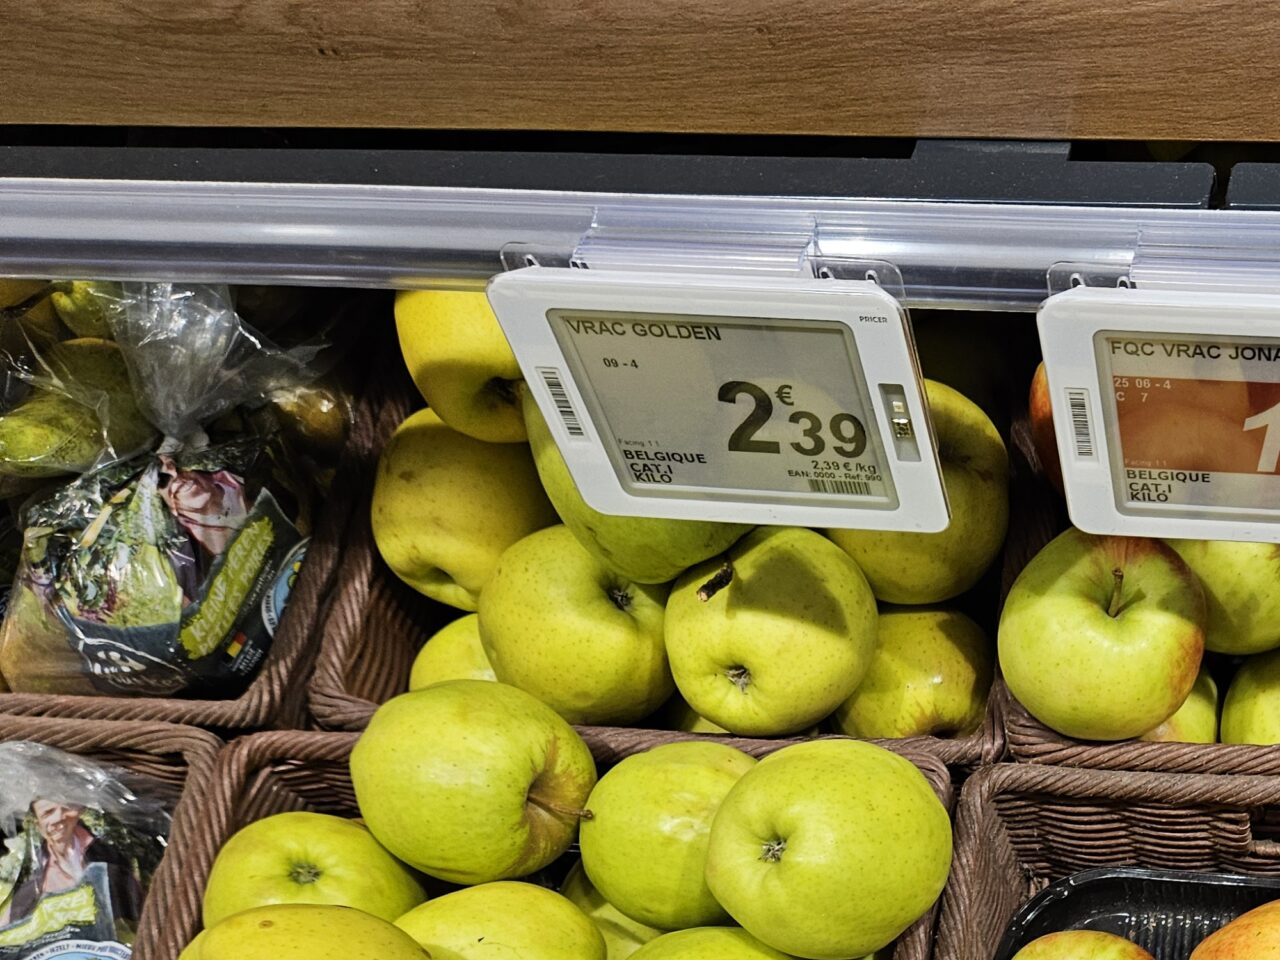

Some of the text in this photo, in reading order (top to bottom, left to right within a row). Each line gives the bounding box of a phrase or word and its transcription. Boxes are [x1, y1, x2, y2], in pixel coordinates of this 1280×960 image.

[566, 319, 722, 341] VRAC GOLDEN
[1110, 340, 1155, 356] FQC
[1160, 343, 1221, 359] VRAC
[602, 357, 619, 368] 09
[630, 358, 639, 369] 4
[1113, 377, 1129, 388] 25
[1163, 379, 1172, 389] 4
[1116, 391, 1148, 403] C 7
[718, 380, 867, 458] 2 € 39
[623, 449, 707, 464] BELGIQUE
[630, 462, 673, 474] CAT.I
[811, 460, 876, 475] 2,39 € /kg
[634, 472, 673, 484] KILO
[787, 469, 812, 477] EAN:
[814, 471, 835, 479] 0000
[1126, 469, 1211, 483] BELGIQUE
[1129, 482, 1172, 493] CAT.I
[1130, 491, 1169, 502] KILO
